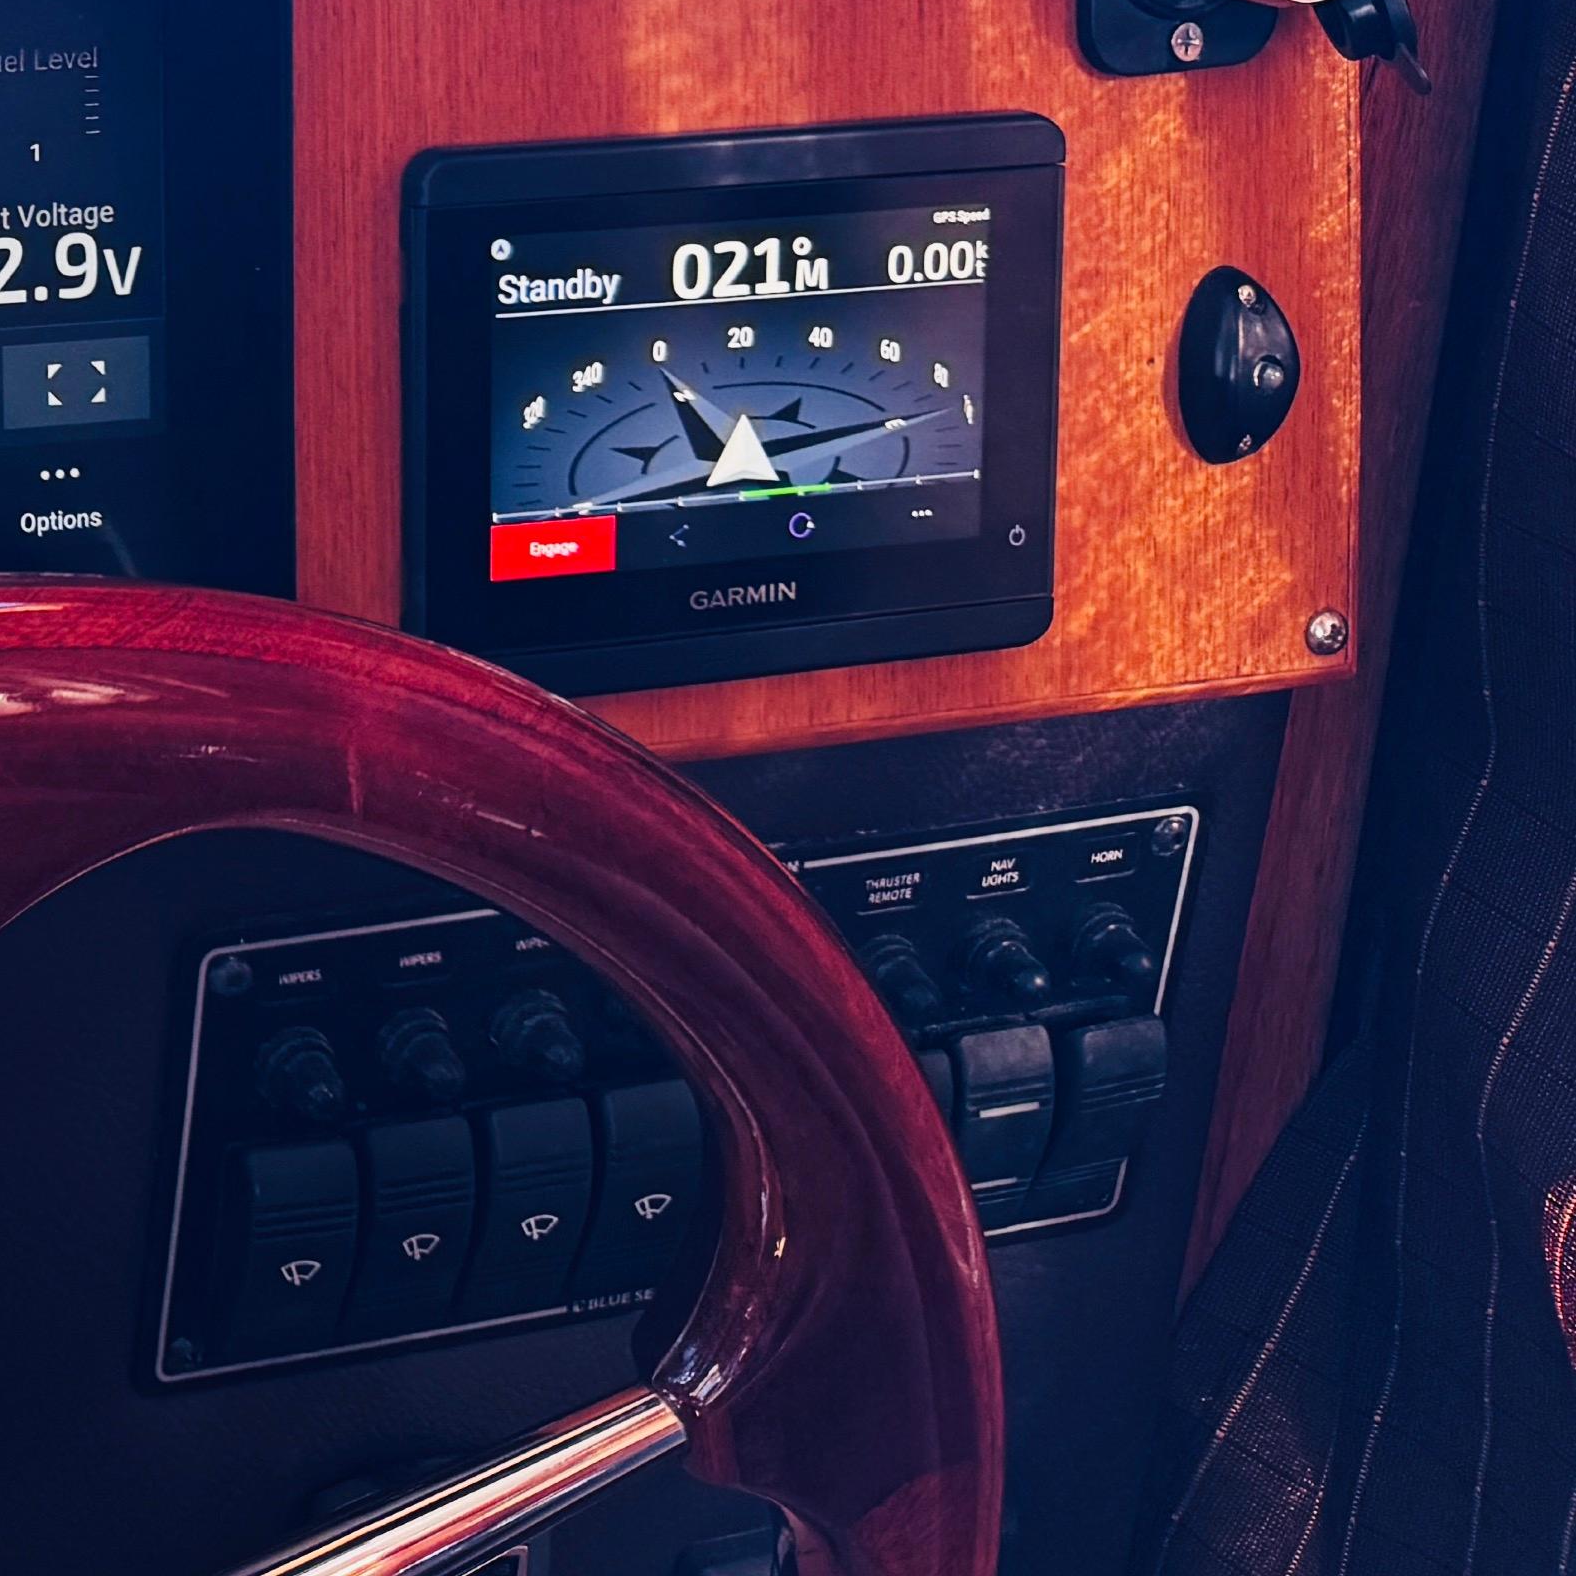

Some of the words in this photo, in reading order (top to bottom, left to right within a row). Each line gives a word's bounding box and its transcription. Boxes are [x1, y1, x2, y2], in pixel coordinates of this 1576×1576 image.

[33, 46, 98, 72] Level
[29, 143, 41, 162] 1
[17, 202, 115, 230] Voltage
[497, 268, 622, 305] Standby
[887, 240, 975, 284] 0.00
[727, 326, 754, 349] 20
[808, 327, 834, 348] 40
[652, 340, 668, 362] 0
[880, 338, 901, 362] 60
[20, 507, 103, 537] Options
[529, 541, 579, 558] Engage
[689, 581, 797, 610] GARMIN
[991, 858, 1016, 872] NAV
[1090, 849, 1124, 864] HORN
[865, 872, 921, 891] THRUSTER
[868, 887, 913, 904] REMOTE
